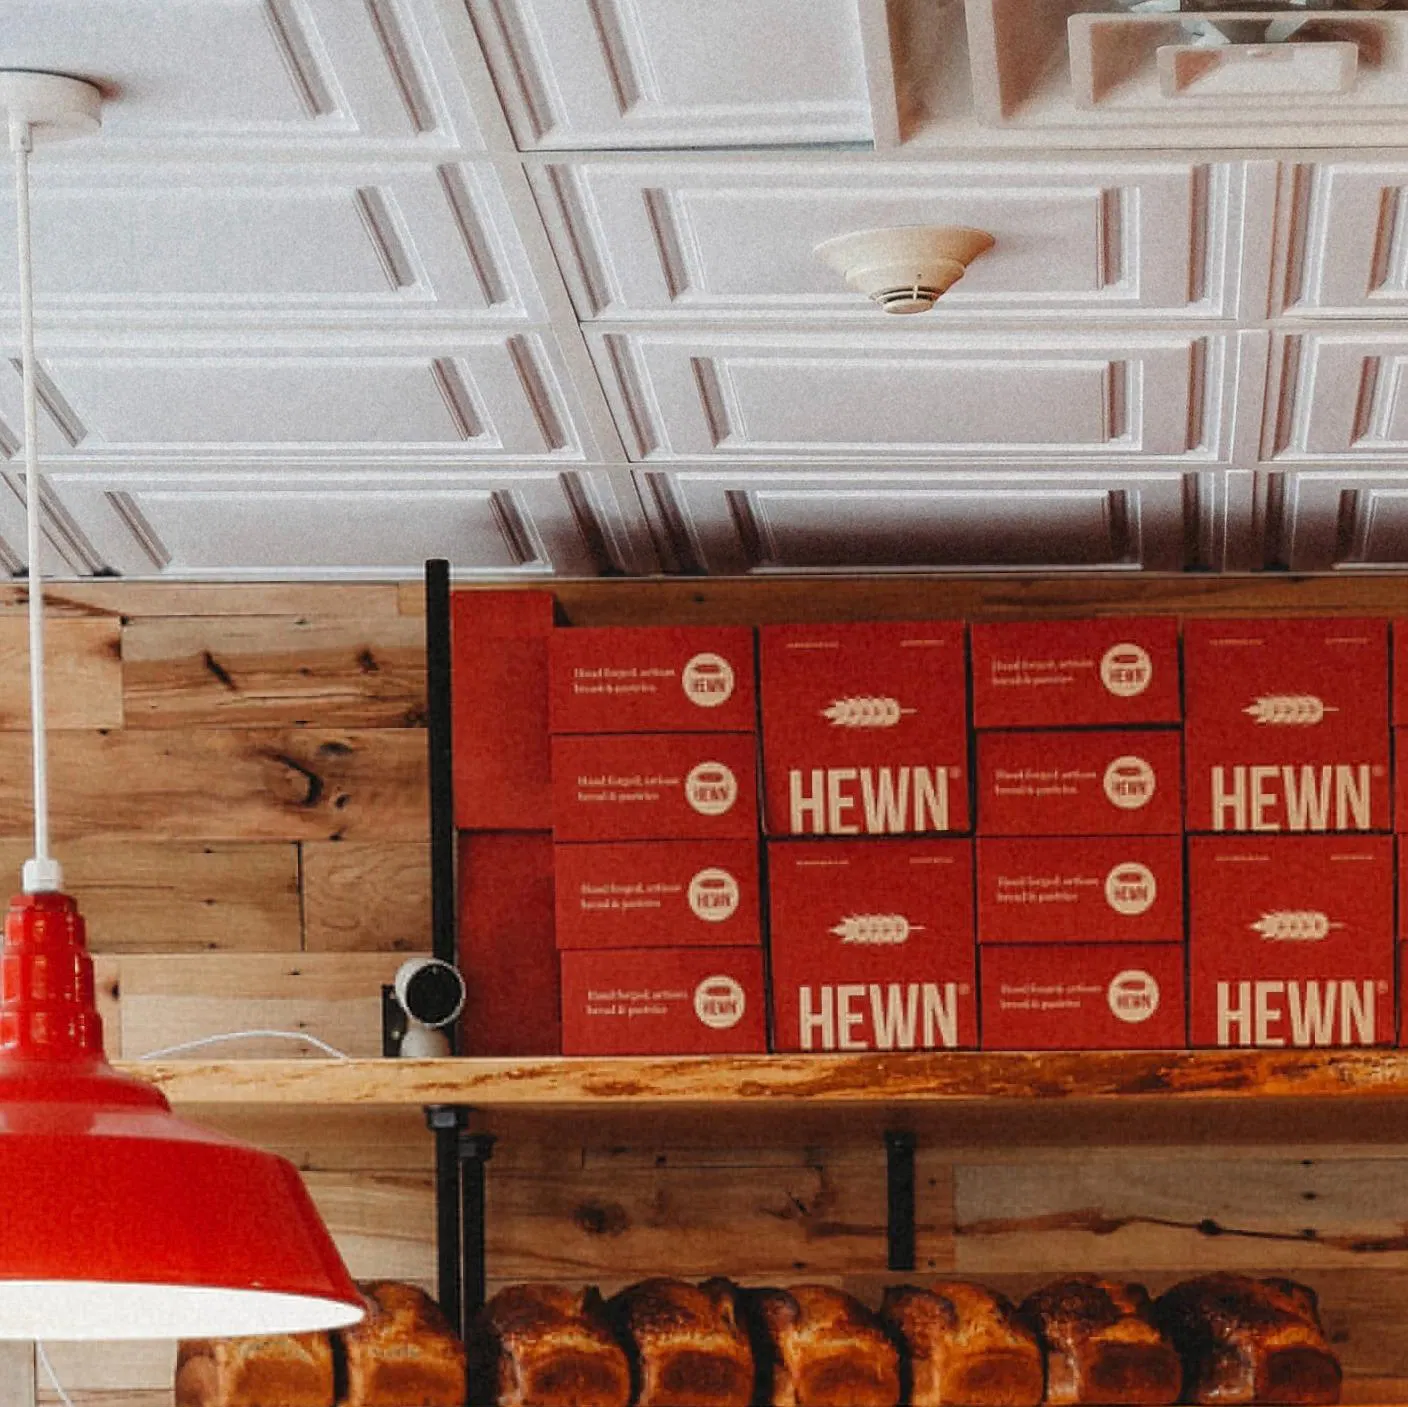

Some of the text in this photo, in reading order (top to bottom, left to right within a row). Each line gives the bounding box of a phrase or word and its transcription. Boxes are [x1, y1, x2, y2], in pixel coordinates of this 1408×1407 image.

[790, 767, 949, 834] HEWN
[1212, 765, 1369, 831] HEWN
[799, 983, 957, 1050] HEWN
[1217, 981, 1374, 1046] HEWN
